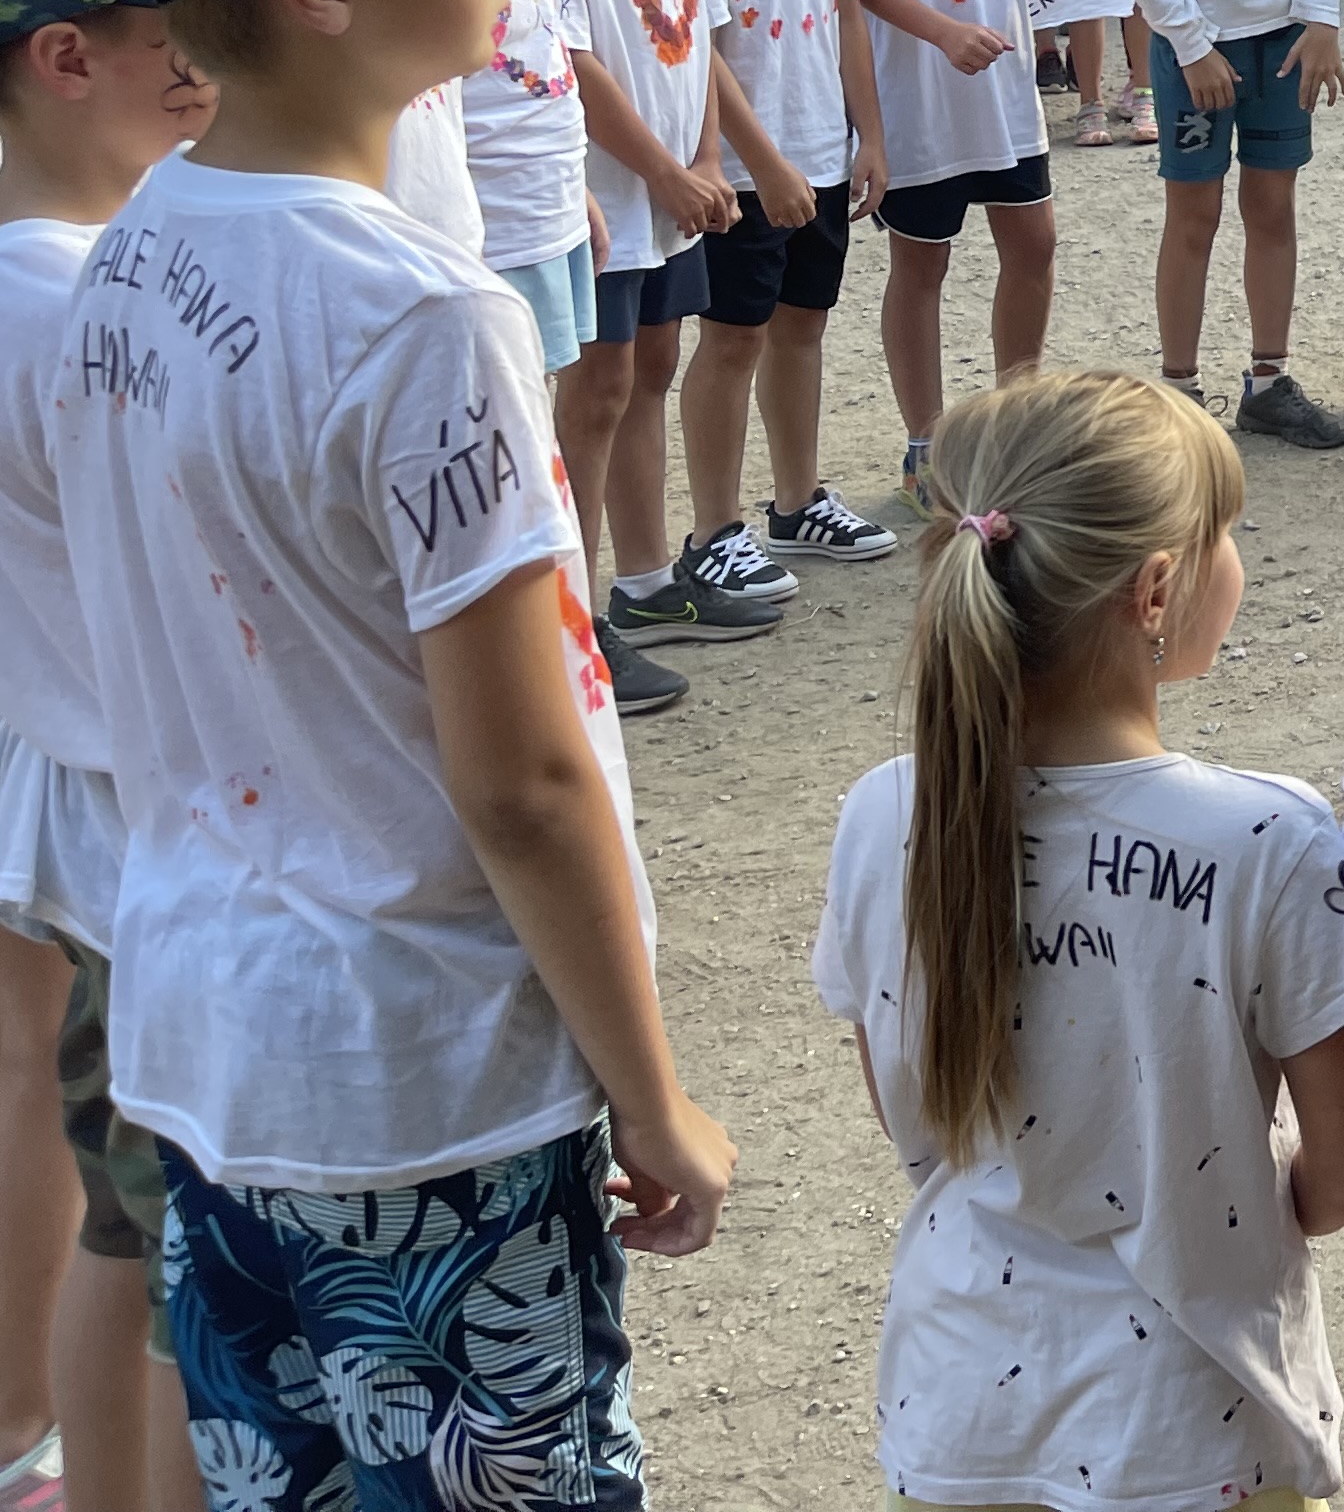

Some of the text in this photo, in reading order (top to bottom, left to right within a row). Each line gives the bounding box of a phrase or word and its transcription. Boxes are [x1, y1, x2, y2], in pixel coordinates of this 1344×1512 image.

[161, 238, 260, 374] HANA
[1087, 831, 1218, 926] HANA
[1018, 920, 1118, 968] WAII
